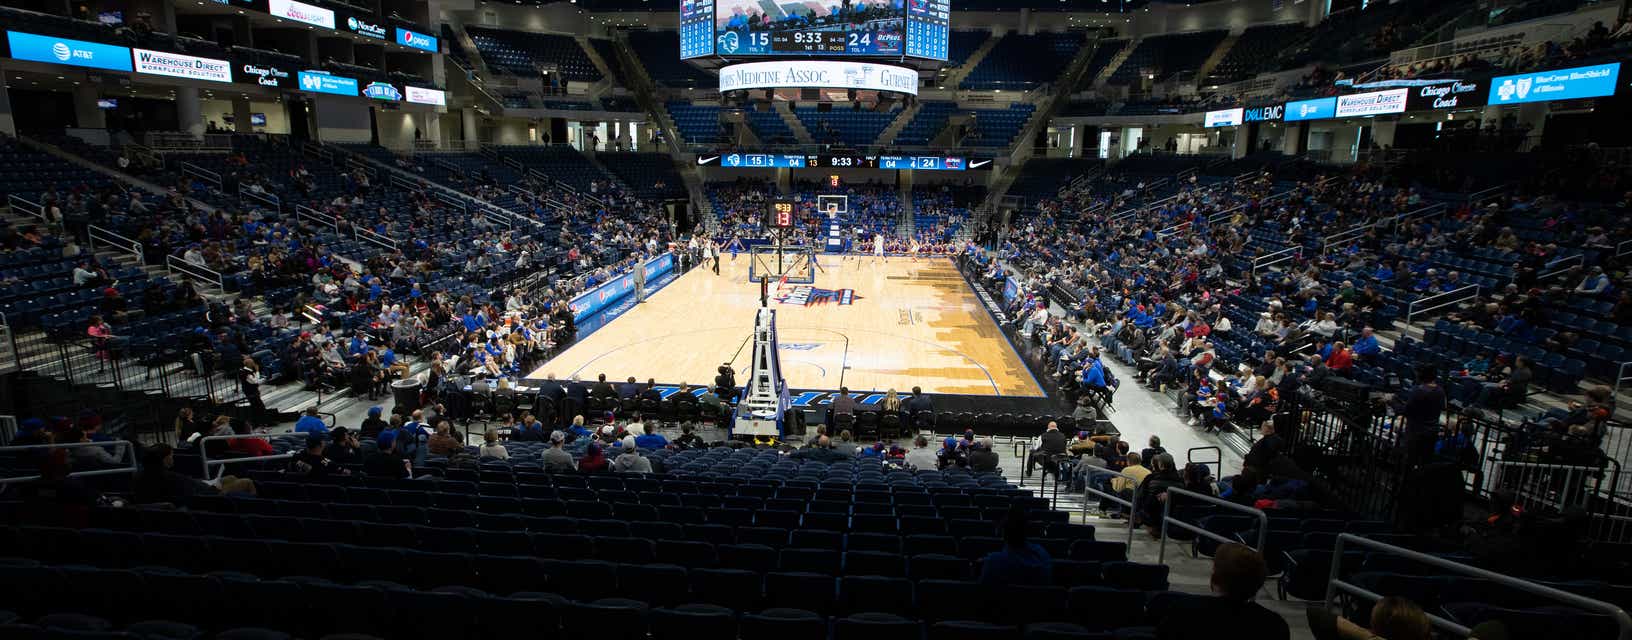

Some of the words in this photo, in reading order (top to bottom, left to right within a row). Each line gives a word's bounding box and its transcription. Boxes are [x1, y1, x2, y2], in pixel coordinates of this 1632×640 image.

[358, 20, 386, 35] NovaCare
[750, 32, 769, 46] 15
[794, 32, 822, 43] 9:33
[848, 33, 871, 46] 24
[72, 49, 94, 60] AT&T
[140, 52, 194, 69] WAREHOUSE
[195, 60, 224, 72] DIRECT
[141, 64, 186, 75] WORKPLACE
[188, 70, 226, 79] SOLUTIONS
[244, 64, 270, 76] Chicago
[258, 77, 279, 87] Coach
[736, 69, 781, 86] MEDICINE
[785, 67, 831, 84] ASSOC.
[1420, 86, 1451, 97] Chicago
[1340, 97, 1376, 107] WAREHOUSE
[1376, 94, 1401, 104] DIRECT
[1433, 96, 1458, 108] Coach
[751, 156, 762, 165] 15
[832, 157, 852, 166] 9:33
[923, 159, 934, 167] 24
[776, 203, 791, 212] 9:33
[778, 212, 789, 226] 13
